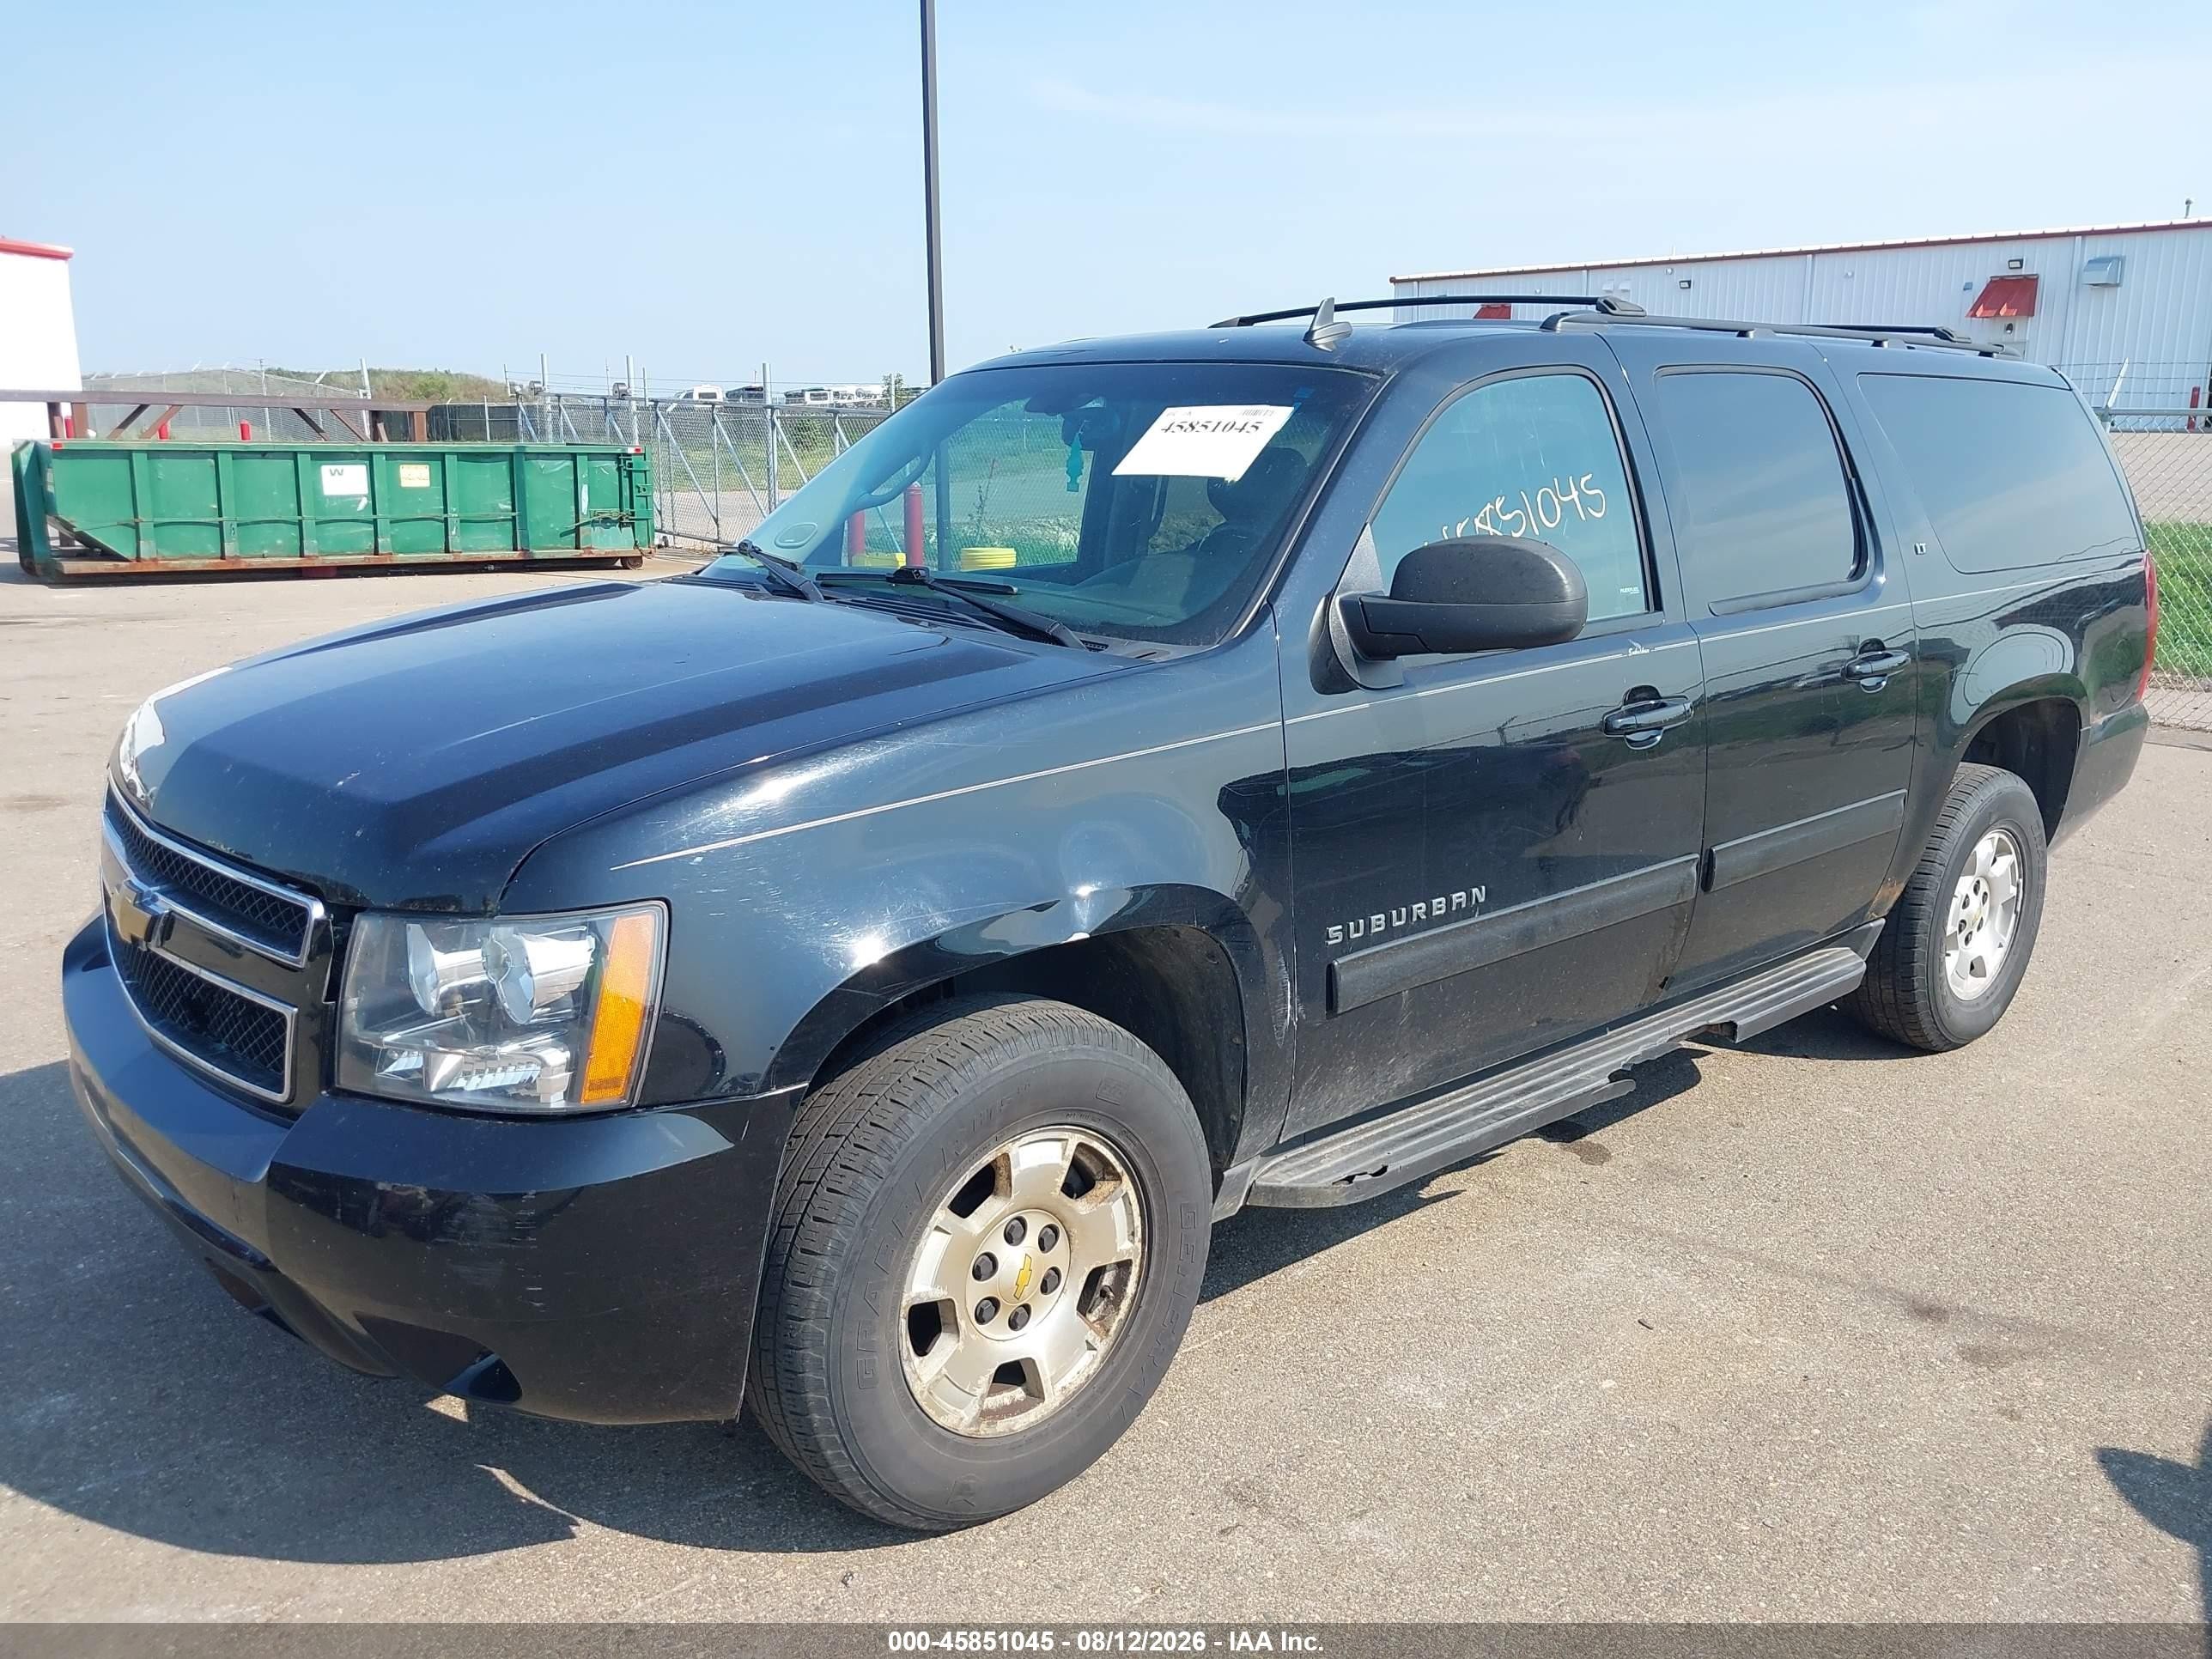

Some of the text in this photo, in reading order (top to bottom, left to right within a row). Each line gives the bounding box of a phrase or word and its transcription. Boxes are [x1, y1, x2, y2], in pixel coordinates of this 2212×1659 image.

[1161, 420, 1263, 434] 45851045
[1914, 543, 1927, 555] LT
[1325, 885, 1486, 945] SUBURBAN
